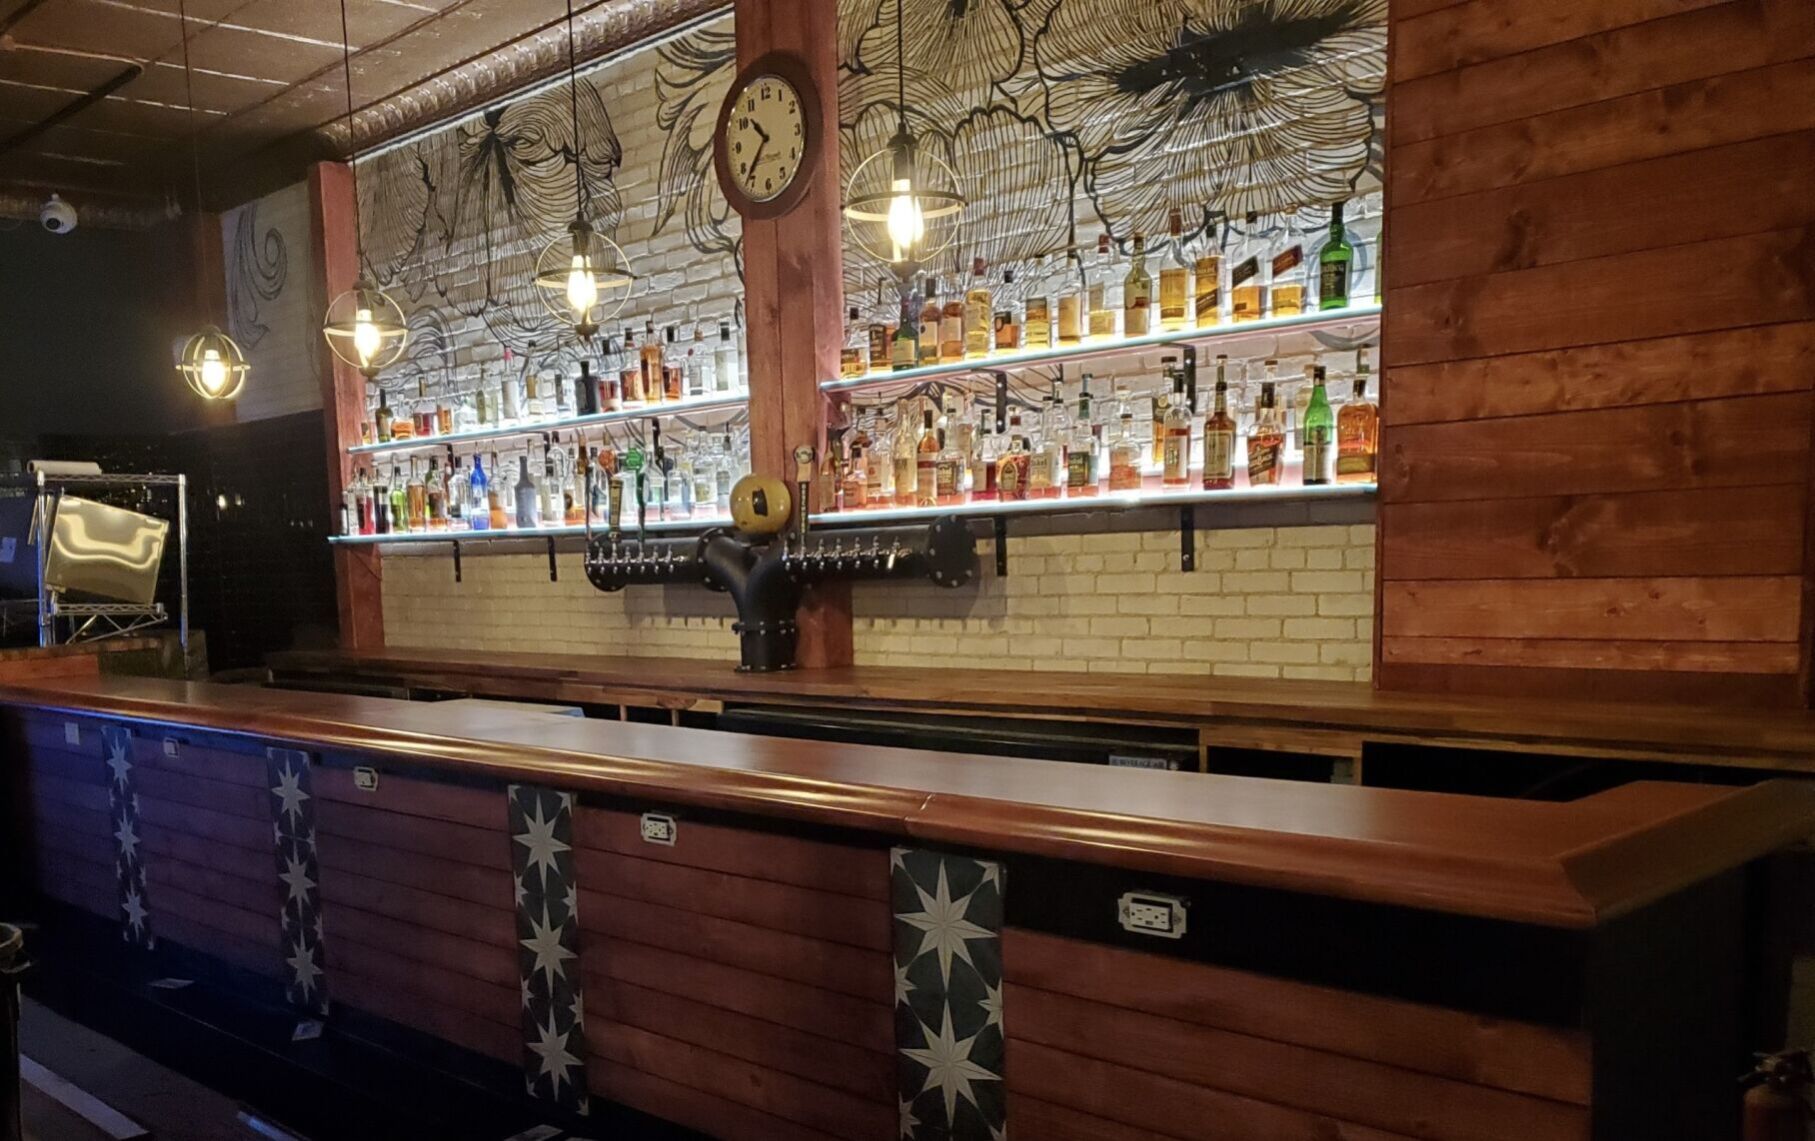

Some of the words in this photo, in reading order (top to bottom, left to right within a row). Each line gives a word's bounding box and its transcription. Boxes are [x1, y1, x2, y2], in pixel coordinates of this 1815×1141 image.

[761, 87, 771, 101] 12
[778, 89, 782, 101] 1
[748, 99, 755, 112] 11
[789, 100, 795, 114] 2
[739, 117, 748, 131] 10
[794, 123, 801, 136] 3
[736, 142, 742, 154] 9
[789, 147, 795, 160] 4
[740, 162, 746, 175] 8
[779, 167, 786, 180] 5
[750, 175, 756, 188] 7
[765, 178, 772, 190] 6
